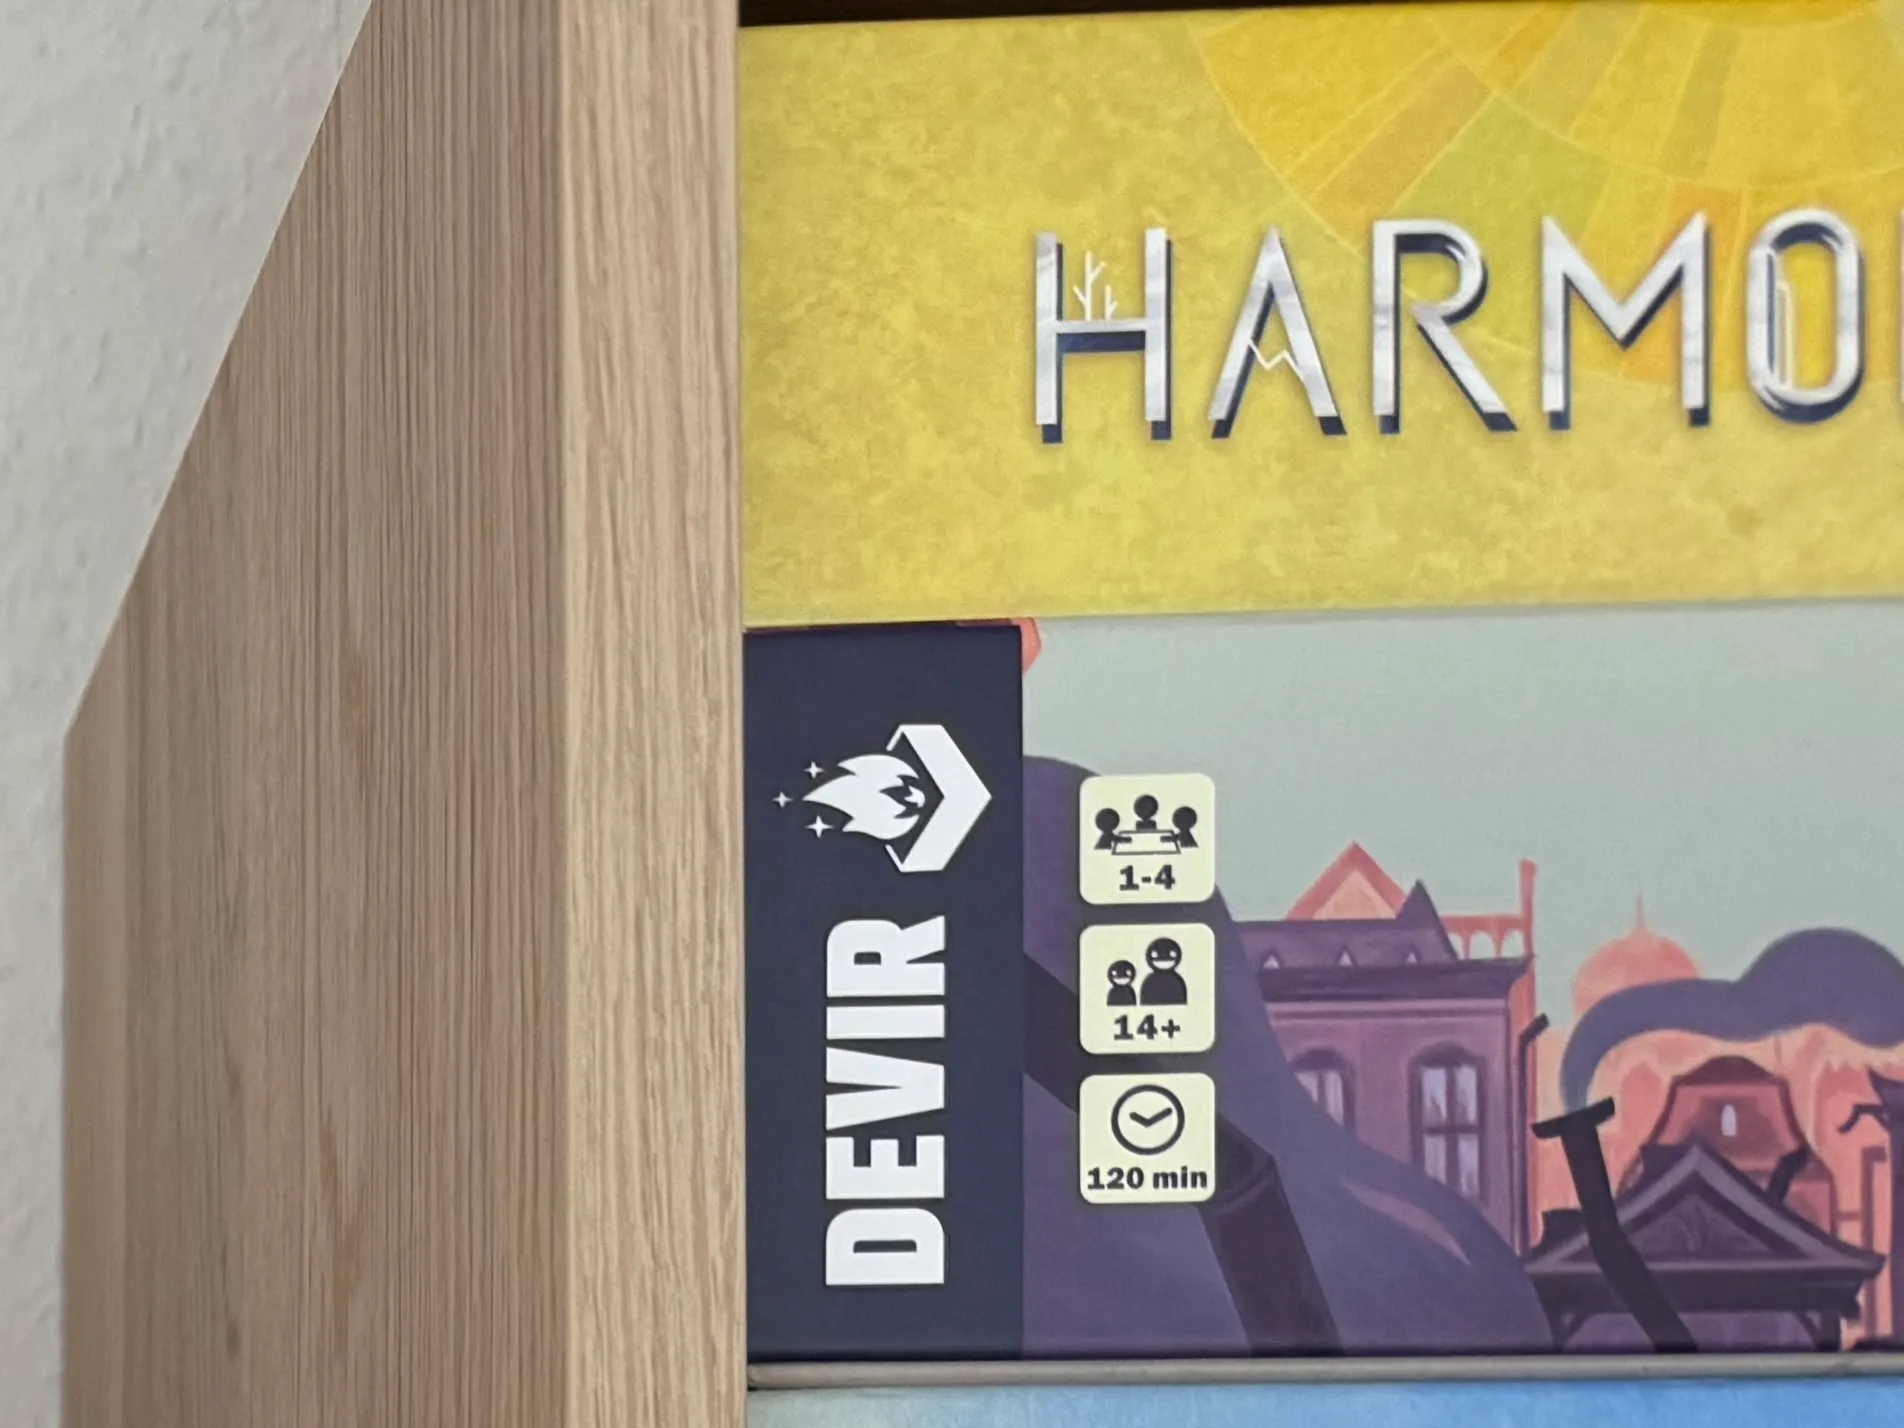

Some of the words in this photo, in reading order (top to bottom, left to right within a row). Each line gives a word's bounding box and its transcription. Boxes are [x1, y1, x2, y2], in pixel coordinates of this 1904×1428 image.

[1034, 205, 1904, 444] HARMO
[1117, 864, 1177, 893] 1-4
[1111, 1014, 1182, 1042] 14+
[824, 914, 947, 1287] DEVIR
[1086, 1165, 1144, 1192] 120
[1149, 1165, 1209, 1192] min
